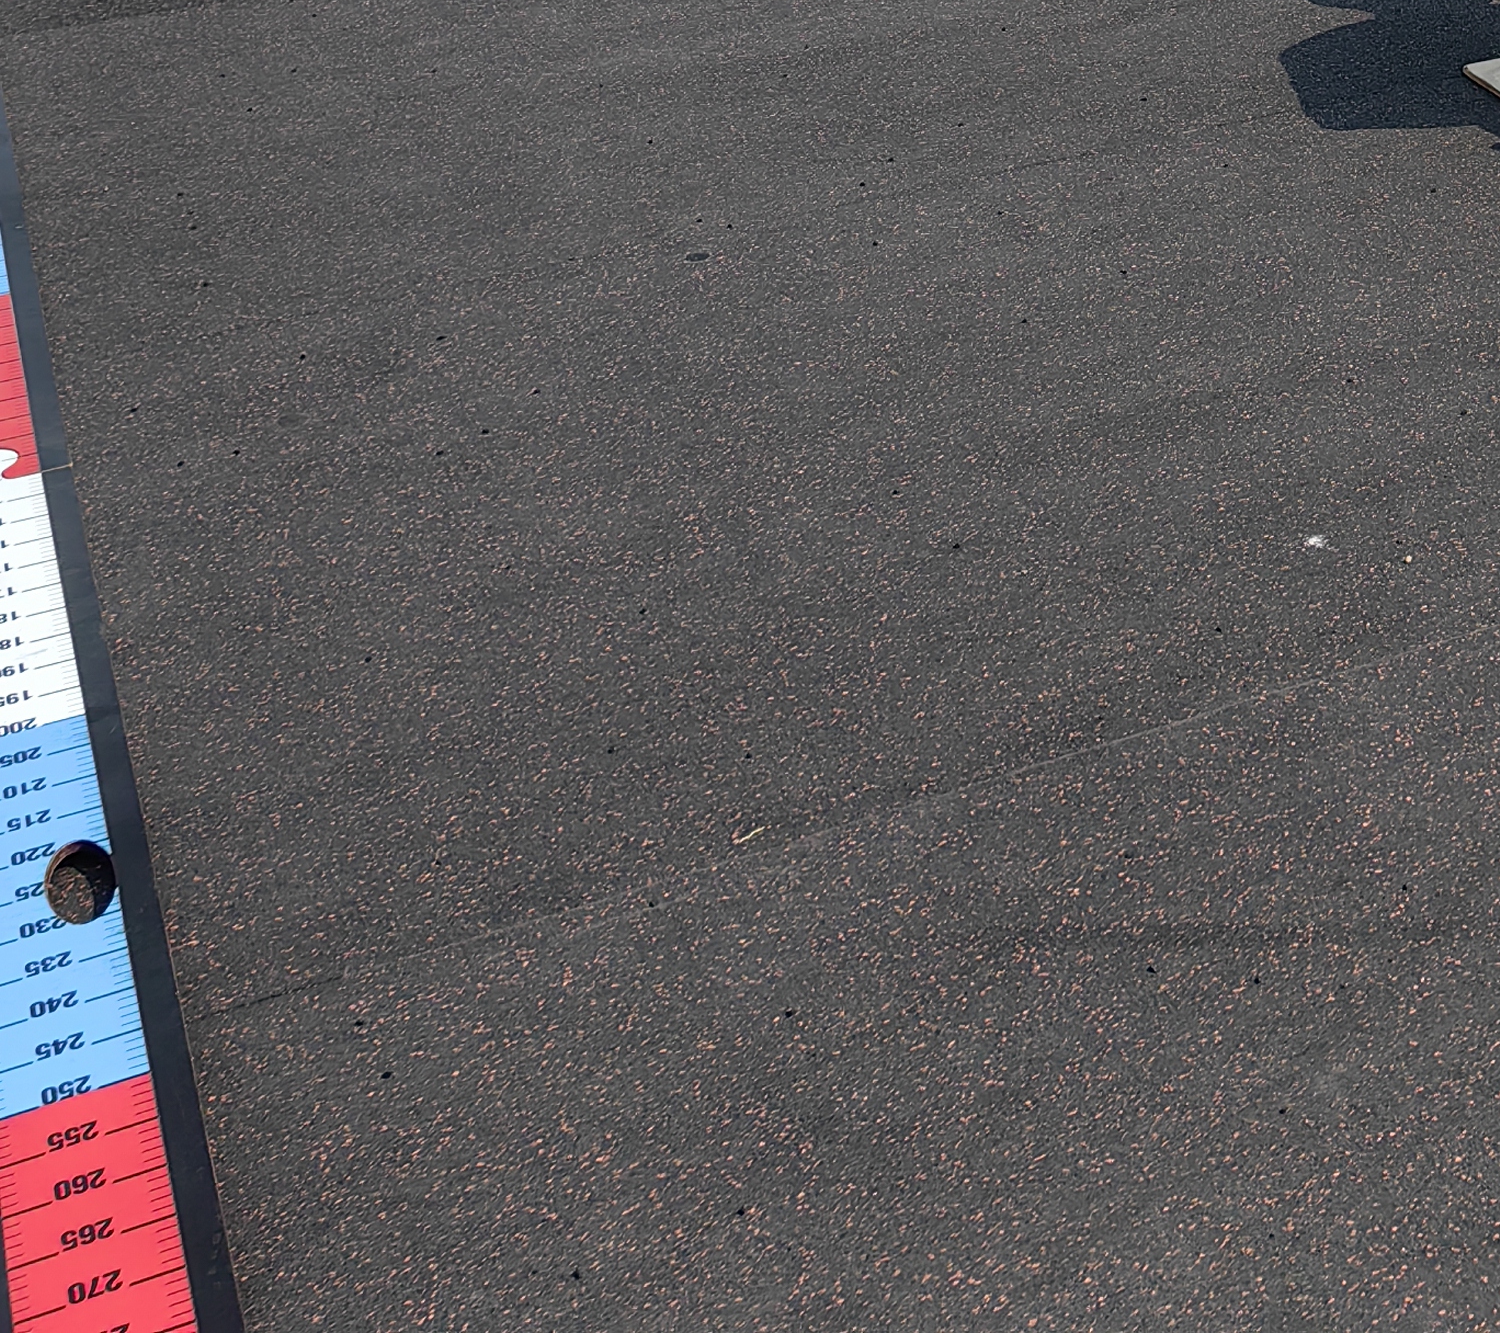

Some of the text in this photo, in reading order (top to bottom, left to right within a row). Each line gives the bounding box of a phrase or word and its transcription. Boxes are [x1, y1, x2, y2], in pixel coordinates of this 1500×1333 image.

[0, 662, 28, 677] 19
[0, 716, 37, 738] 200
[0, 746, 42, 768] 205
[3, 777, 47, 800] 210
[7, 809, 51, 833] 215
[11, 842, 56, 867] 220
[15, 881, 45, 902] 25
[24, 950, 73, 978] 235
[30, 990, 79, 1018] 240
[35, 1031, 86, 1062] 245
[41, 1074, 92, 1106] 250
[47, 1120, 99, 1153] 255
[53, 1167, 107, 1201] 260
[60, 1217, 115, 1253] 265
[67, 1268, 124, 1305] 270
